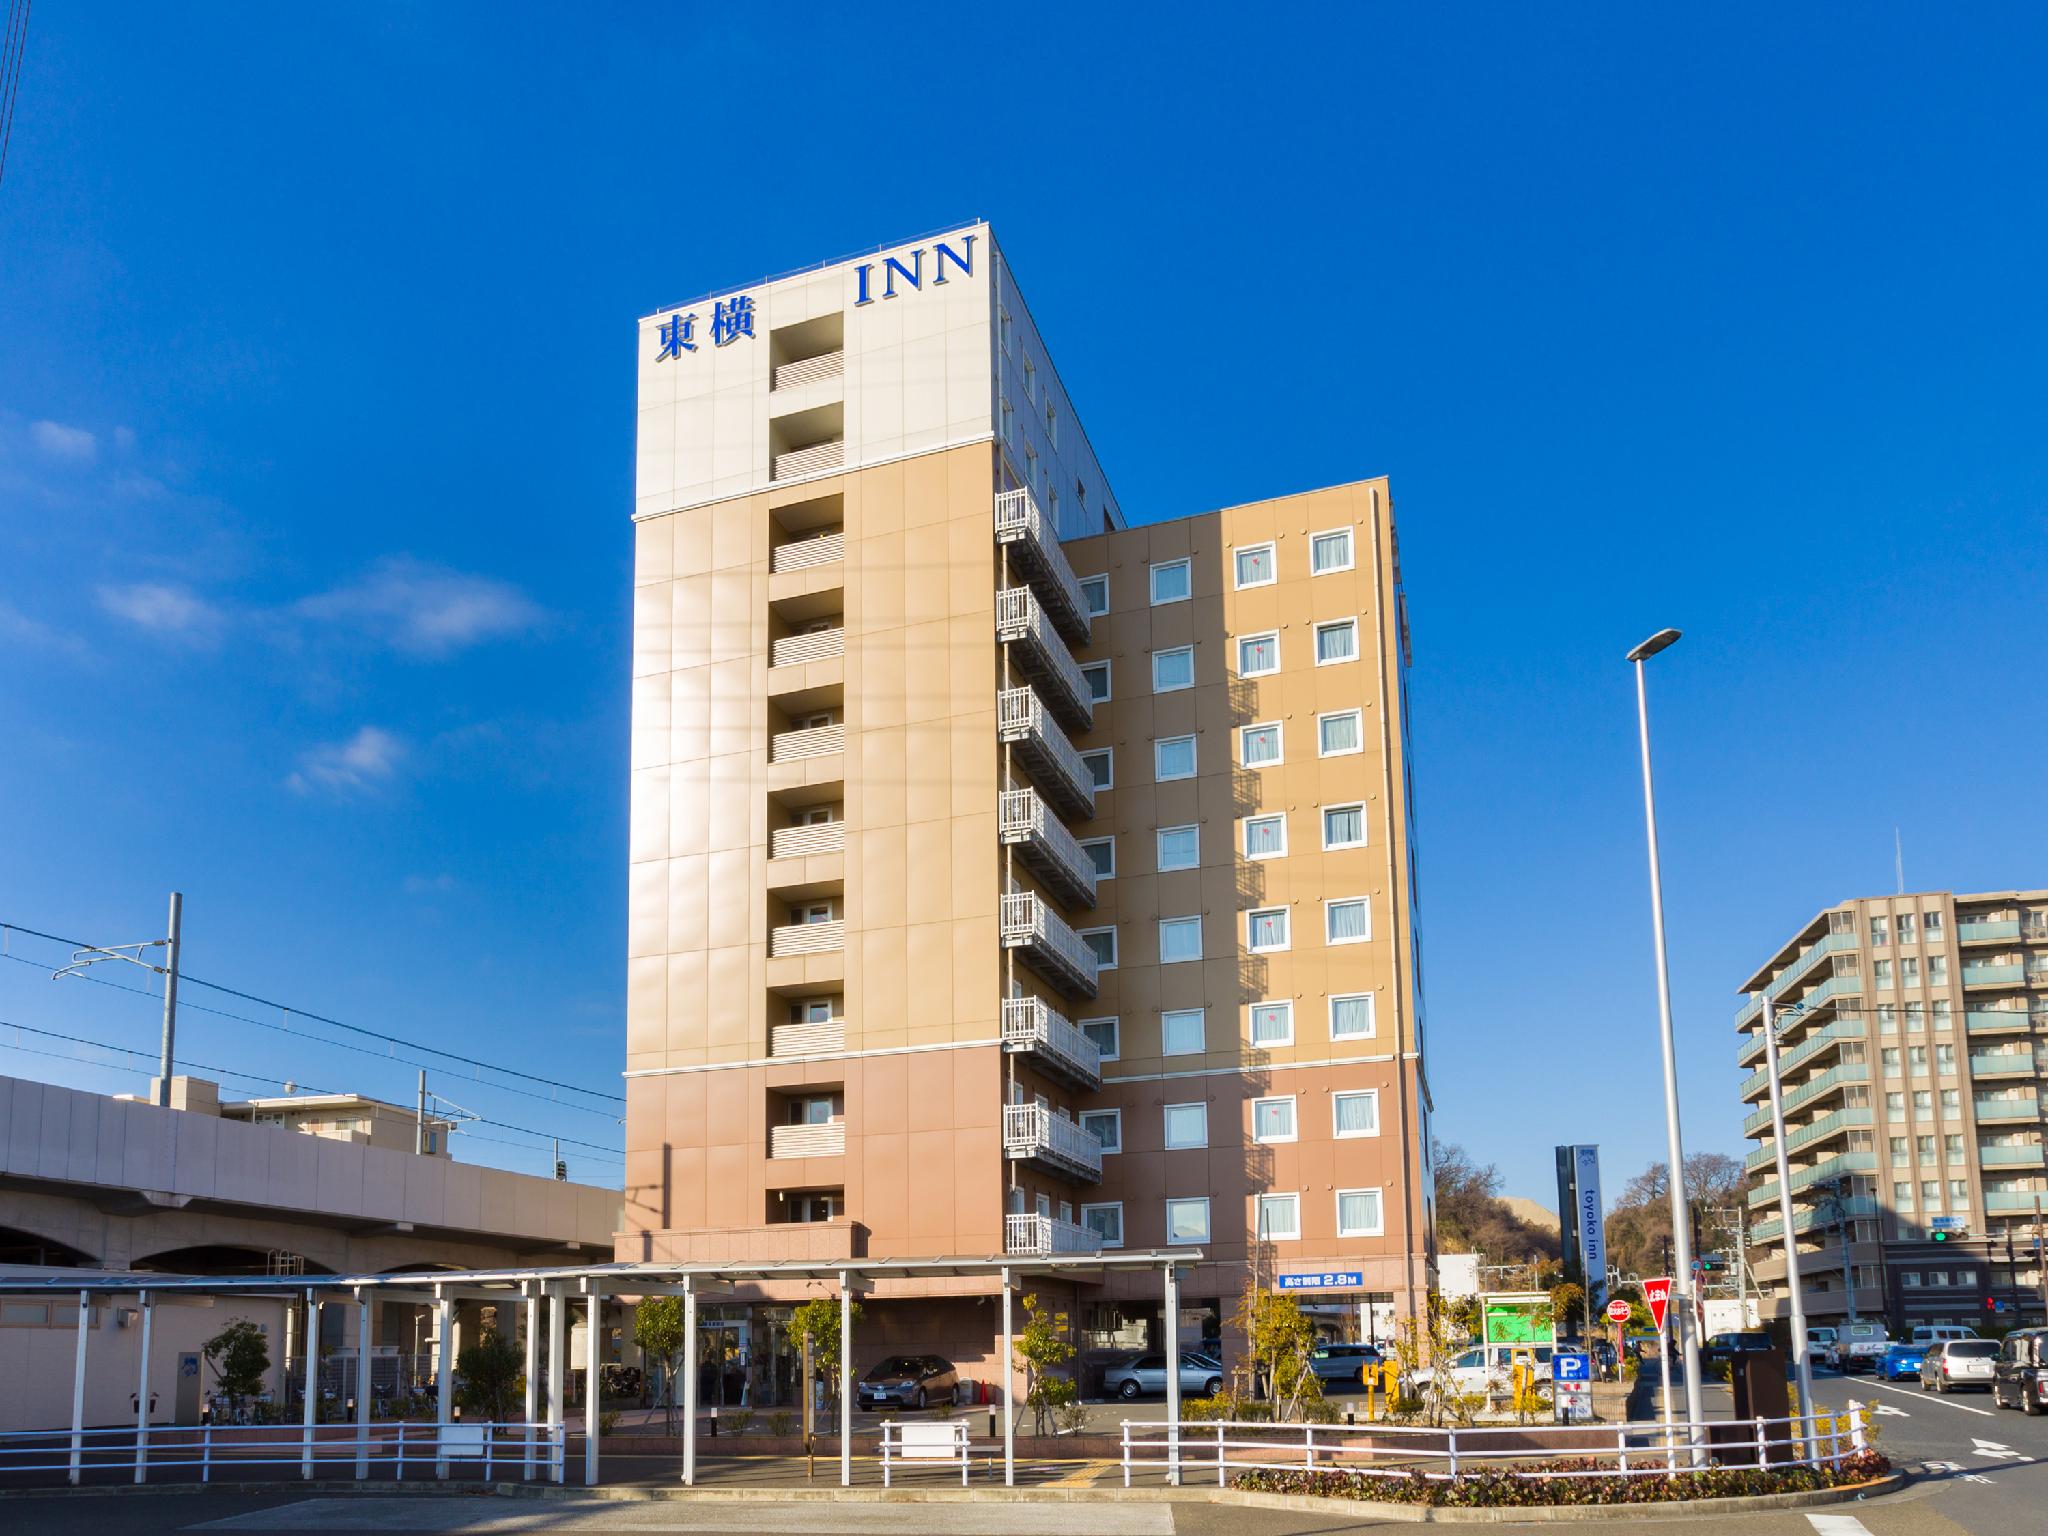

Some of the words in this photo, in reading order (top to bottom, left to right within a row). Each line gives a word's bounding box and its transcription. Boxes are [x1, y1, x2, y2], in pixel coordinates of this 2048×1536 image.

[655, 295, 756, 362] 東横
[855, 236, 977, 307] INN
[1584, 1189, 1597, 1235] toyoko
[1589, 1240, 1598, 1259] inn
[1560, 1358, 1581, 1377] P
